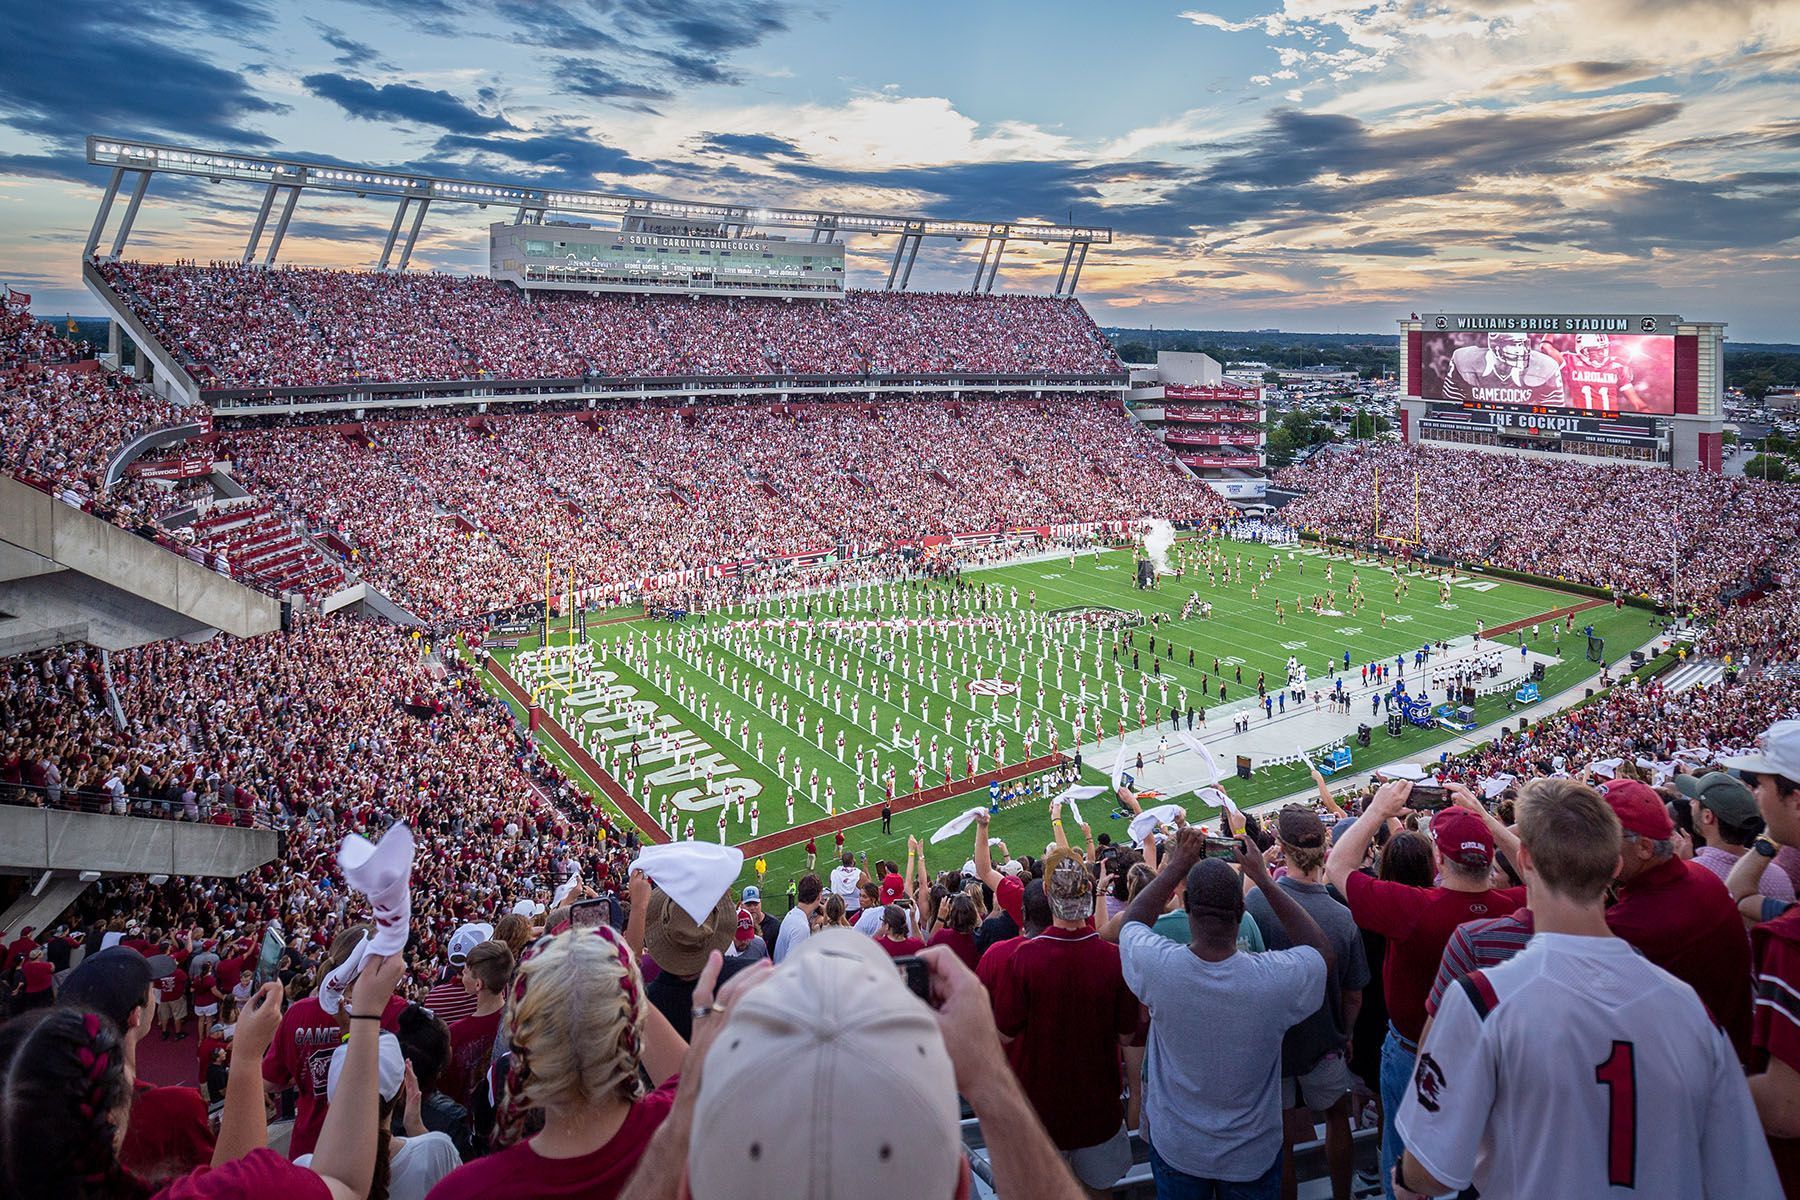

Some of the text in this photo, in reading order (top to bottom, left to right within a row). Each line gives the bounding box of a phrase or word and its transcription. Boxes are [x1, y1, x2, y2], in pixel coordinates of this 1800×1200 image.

[630, 235, 760, 251] SOUTH CAROLINA GAMECOCKS
[1457, 317, 1628, 331] WILLIAMS-BRICE STADIUM
[1472, 387, 1533, 403] GAMECOCKS
[1581, 385, 1609, 410] 11
[1489, 413, 1580, 431] THE COCKPIT
[141, 468, 179, 477] NORWOOD
[1460, 841, 1486, 851] CAROLINA
[1595, 1039, 1636, 1189] 1
